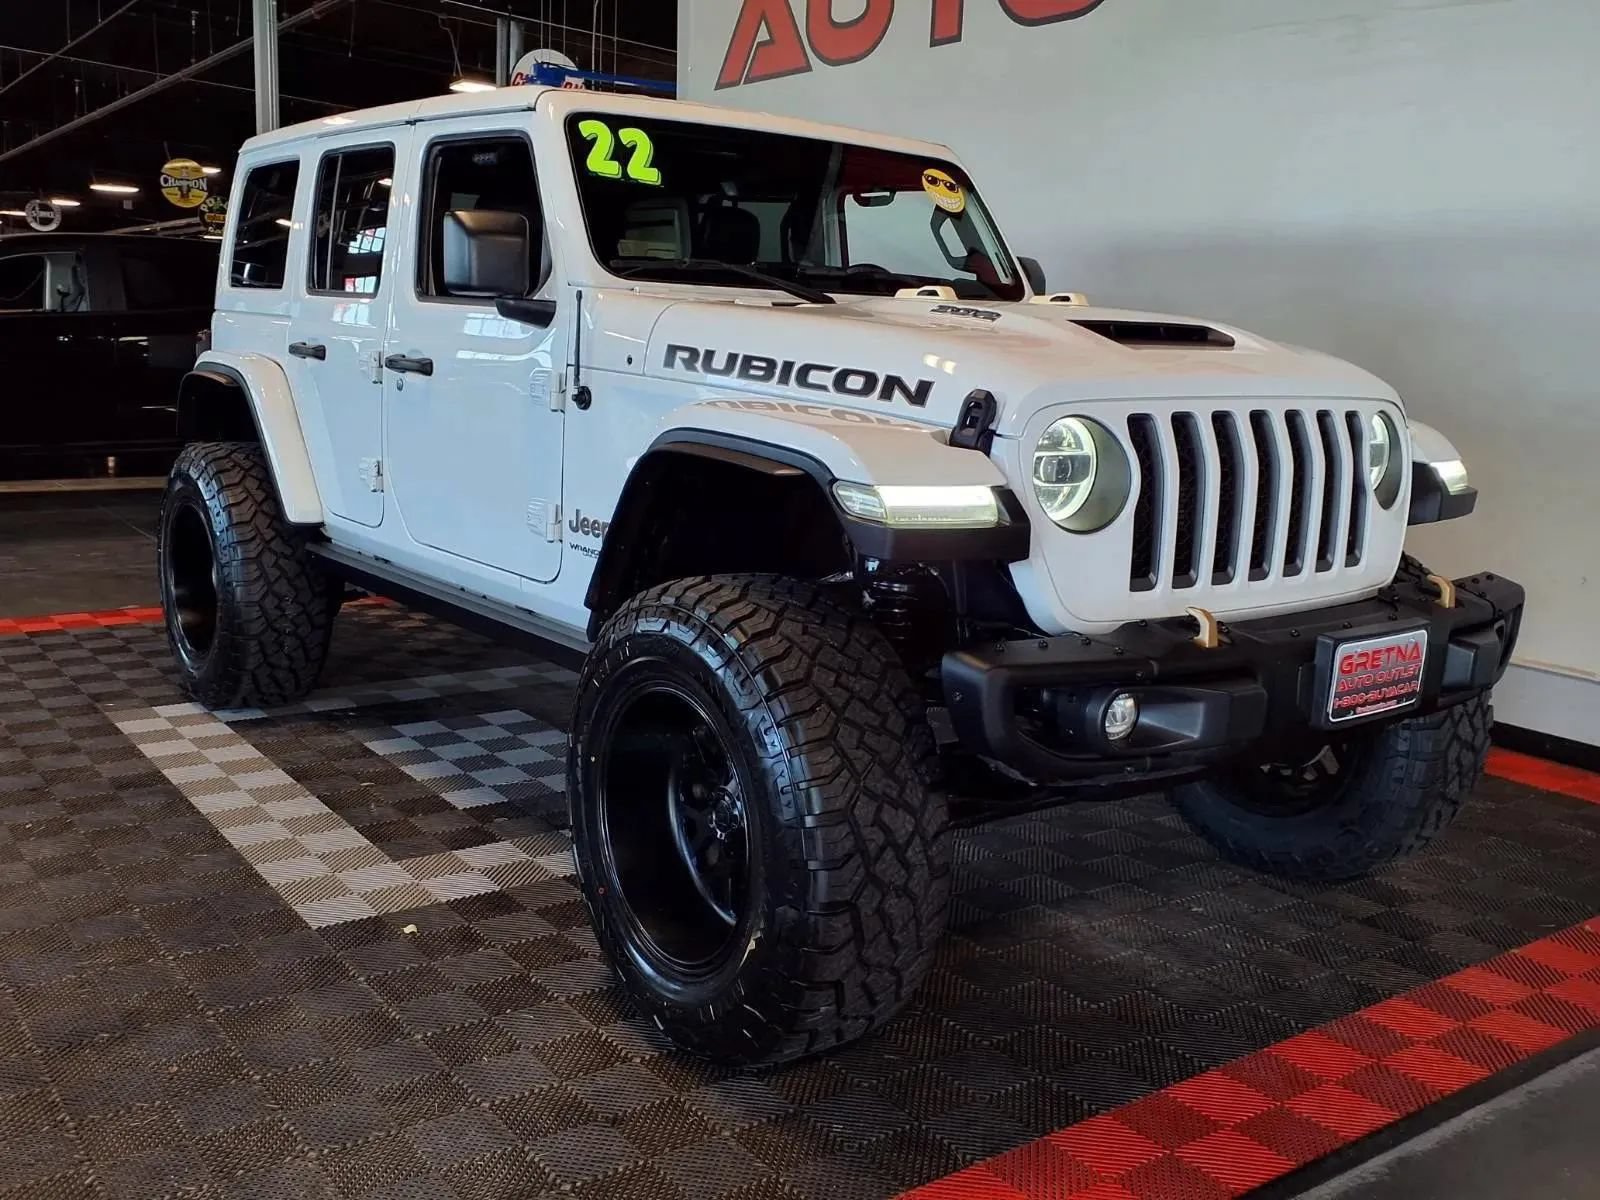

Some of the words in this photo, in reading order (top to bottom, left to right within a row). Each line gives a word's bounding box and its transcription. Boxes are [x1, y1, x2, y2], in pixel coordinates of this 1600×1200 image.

[714, 0, 1101, 90] AU
[578, 119, 662, 186] 22
[160, 174, 208, 192] CHAION
[662, 343, 936, 409] RUBICON
[1336, 673, 1374, 693] AUTO
[1376, 663, 1421, 684] OUTLET
[1340, 641, 1422, 676] GRETNA
